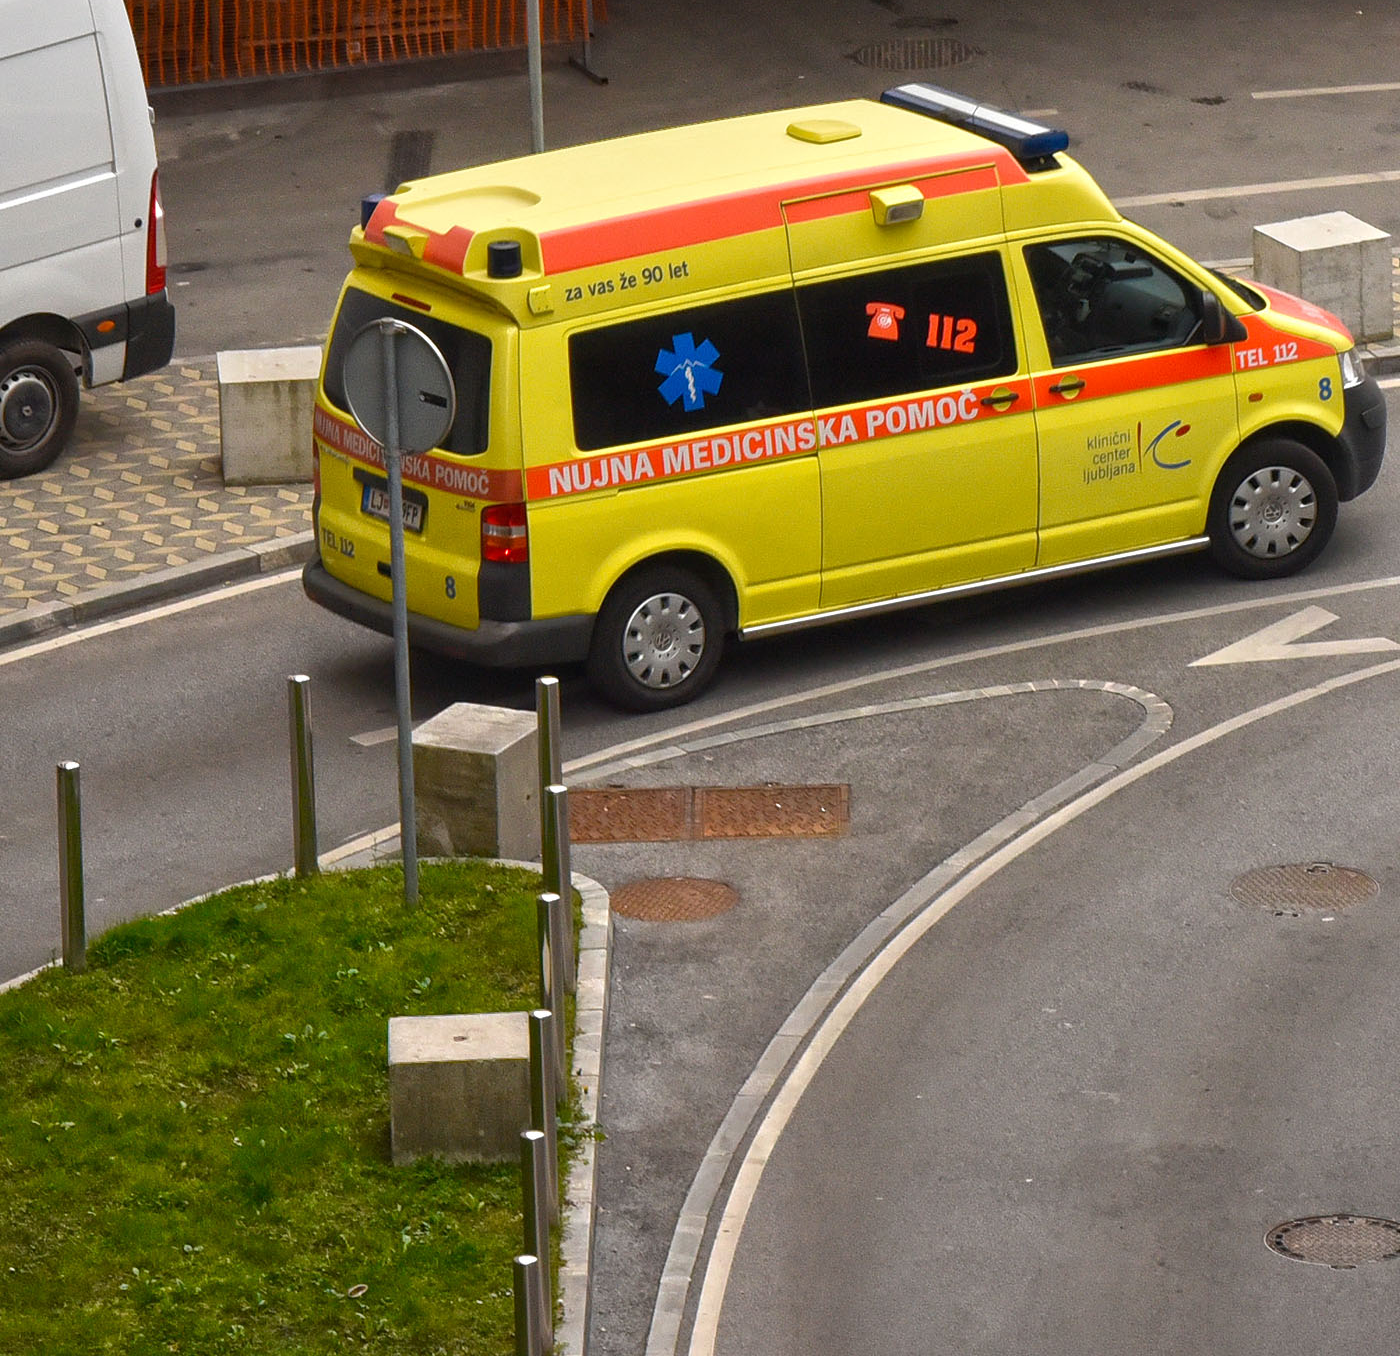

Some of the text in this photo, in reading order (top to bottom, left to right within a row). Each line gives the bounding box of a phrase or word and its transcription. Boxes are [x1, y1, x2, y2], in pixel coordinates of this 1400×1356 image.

[565, 261, 689, 301] za vas že 90 let
[926, 313, 977, 354] 112
[1236, 342, 1299, 369] TEL 112
[1319, 377, 1332, 401] 8
[549, 388, 979, 495] NUJNA MEDICINSKA POMOČ
[1087, 429, 1131, 450] klinični
[1092, 447, 1131, 465] center
[435, 464, 489, 495] POMOČ
[1082, 462, 1136, 485] ljubljana
[322, 527, 355, 558] TEL 112
[445, 575, 456, 599] 8
